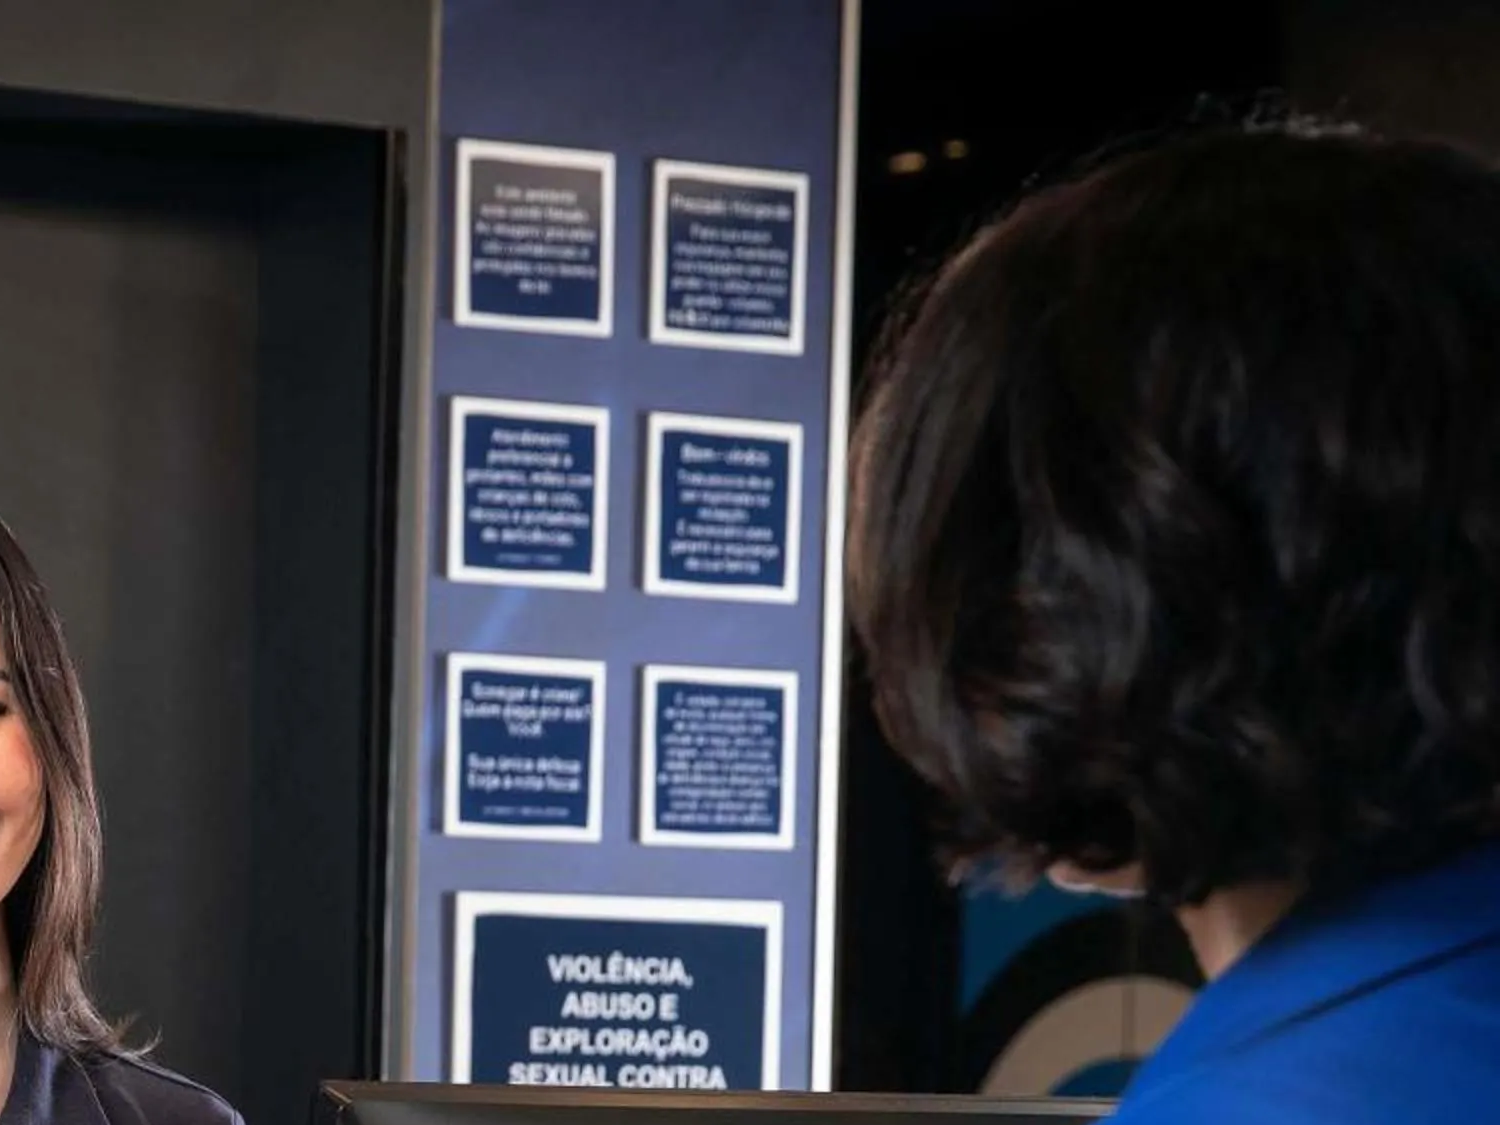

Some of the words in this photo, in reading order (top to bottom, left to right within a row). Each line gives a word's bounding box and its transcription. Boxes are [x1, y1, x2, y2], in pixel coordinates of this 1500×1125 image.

[547, 950, 694, 988] VIOLÊNCIA,
[561, 991, 655, 1021] ABUSO
[658, 993, 679, 1022] E
[529, 1024, 709, 1061] EXPLORAÇÃO
[508, 1062, 613, 1086] SEXUAL
[618, 1064, 728, 1089] CONTRA
